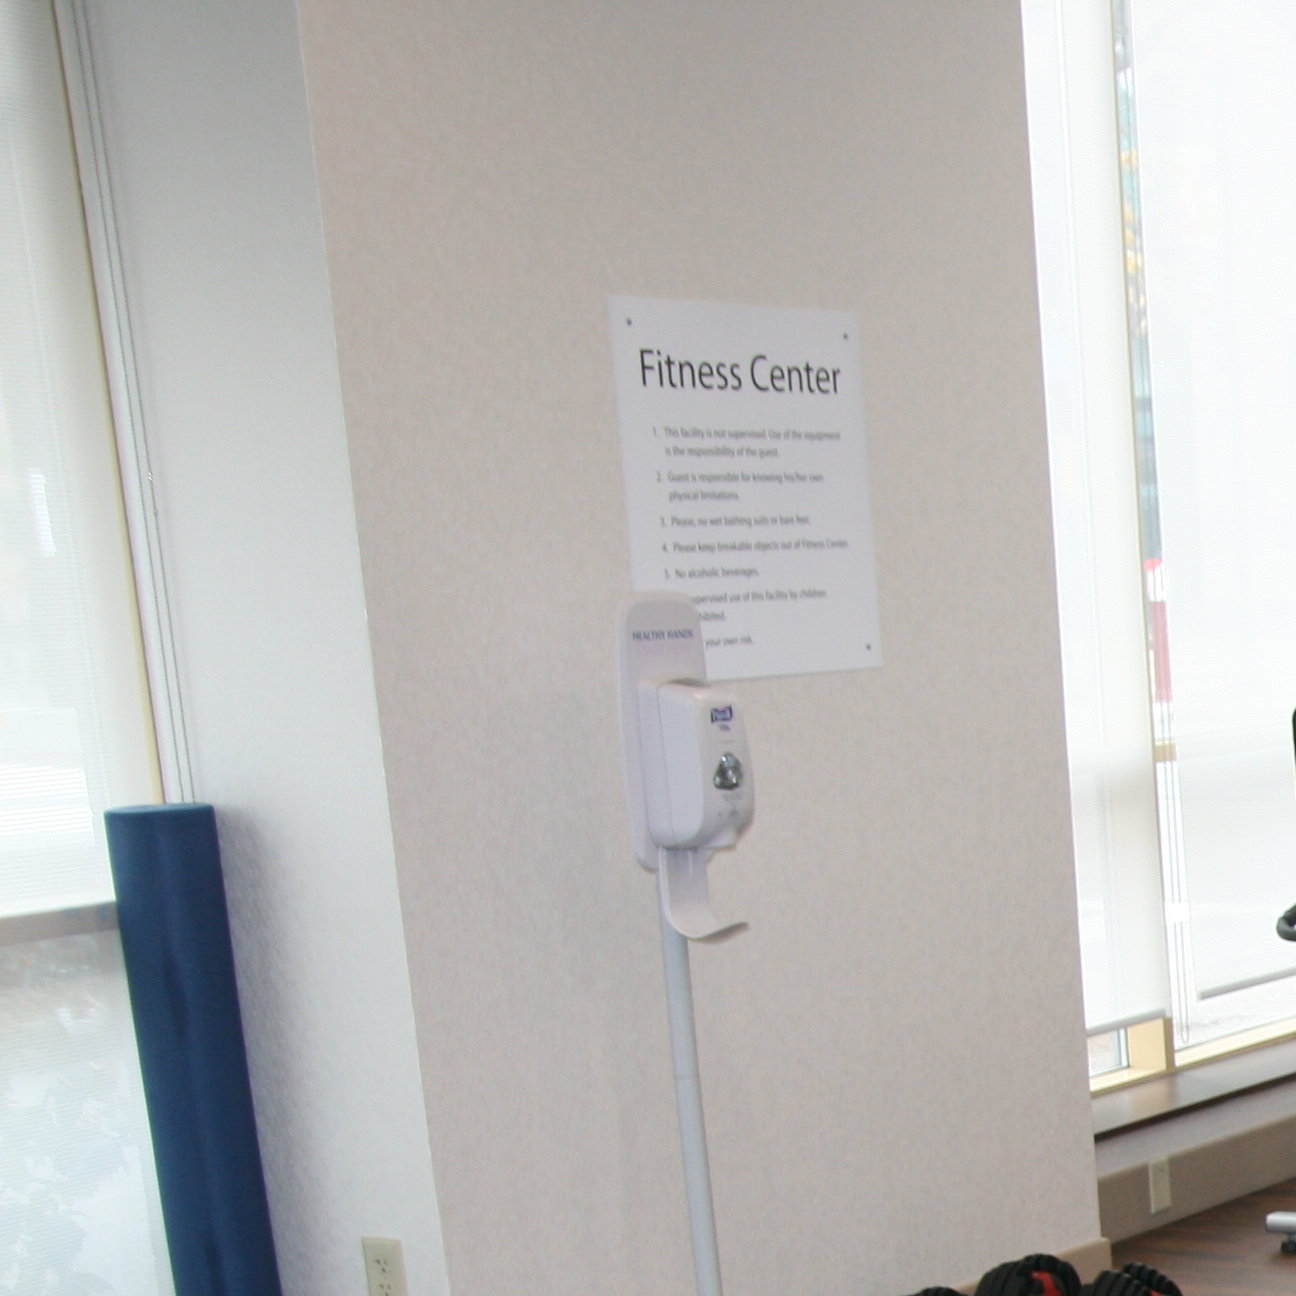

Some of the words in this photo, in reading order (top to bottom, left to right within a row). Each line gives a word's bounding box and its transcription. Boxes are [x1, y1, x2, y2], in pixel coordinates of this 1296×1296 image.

[638, 347, 743, 391] Fitness
[750, 354, 841, 394] Center
[672, 446, 685, 456] the
[687, 447, 734, 458] responsibility
[744, 446, 756, 457] the
[631, 630, 666, 641] HEALTHY
[666, 627, 695, 640] HANDS
